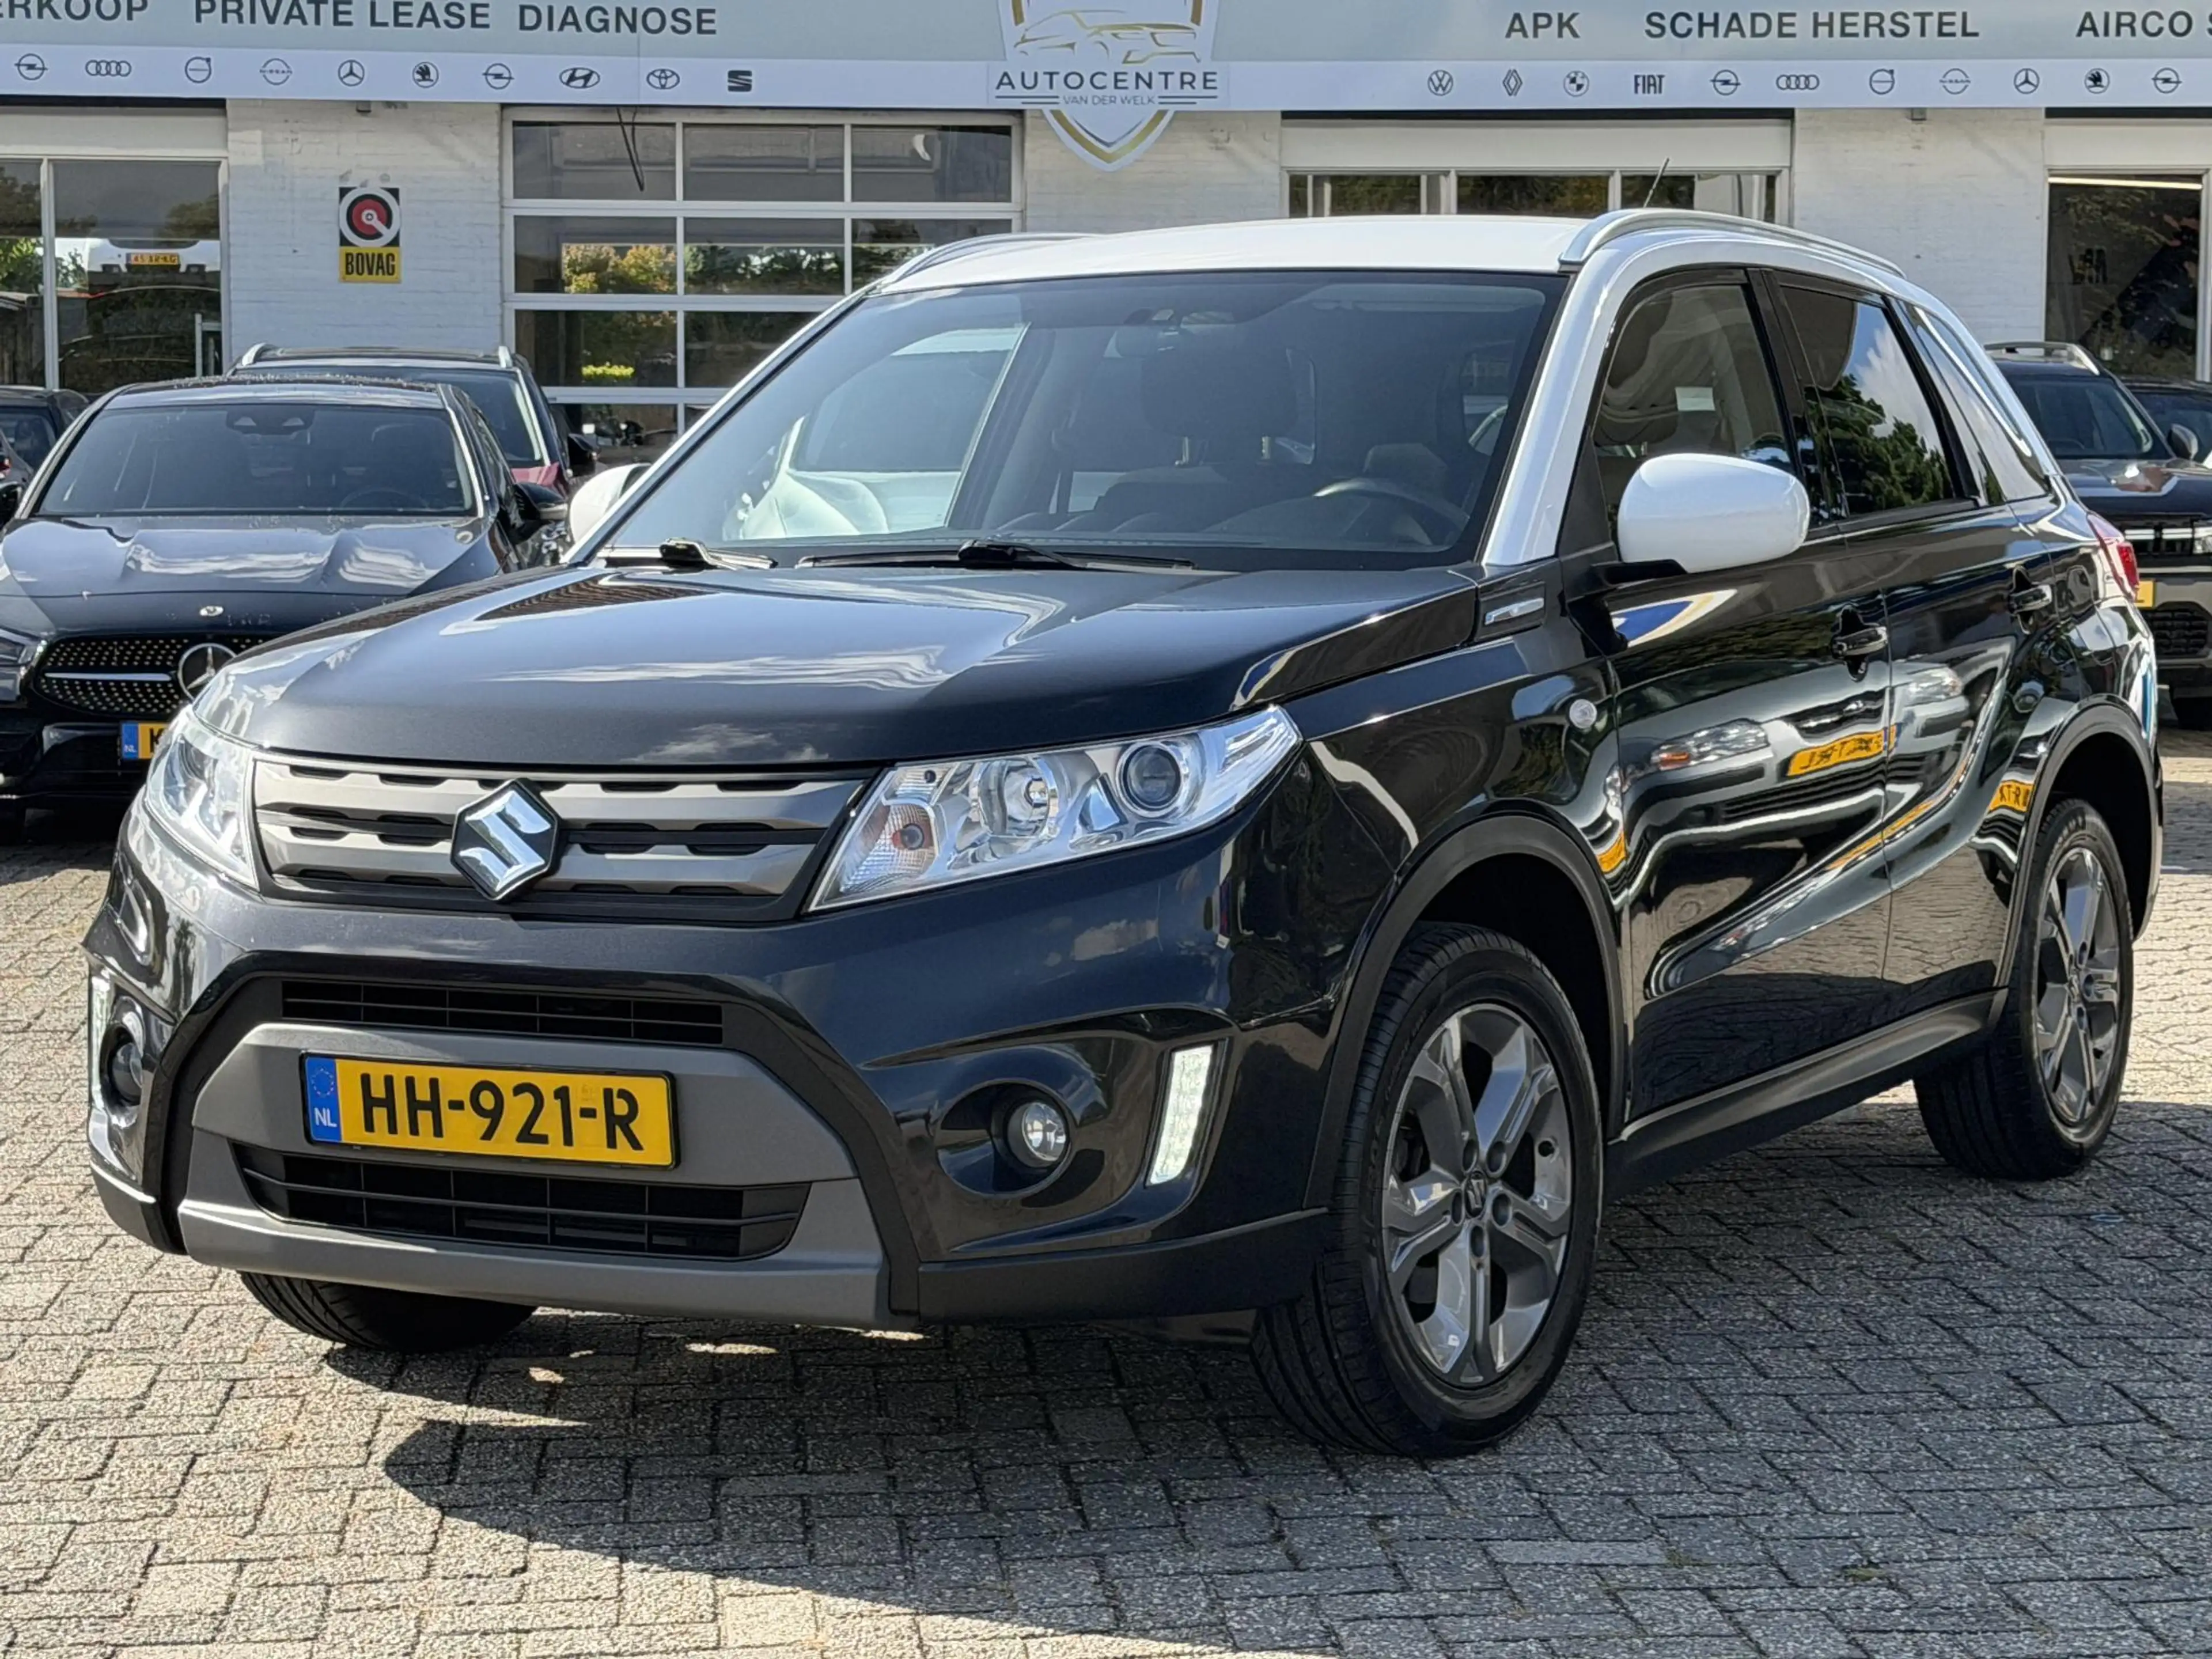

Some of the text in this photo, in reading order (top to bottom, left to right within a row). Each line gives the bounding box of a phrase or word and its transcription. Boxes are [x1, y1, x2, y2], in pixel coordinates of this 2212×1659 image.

[0, 0, 148, 21] RKOOP
[195, 0, 490, 29] PRIVATE LEASE
[518, 4, 717, 35] DIAGNOSE
[1505, 12, 1580, 39] APK
[1645, 11, 1980, 39] SCHADE HERSTEL
[2075, 10, 2193, 37] AIRCO
[995, 71, 1218, 90] AUTOCENTRE
[1634, 74, 1665, 94] FIAT
[1063, 94, 1155, 105] VAN DER WELK
[345, 252, 395, 276] BOVAG
[314, 1107, 337, 1128] NL
[360, 1072, 644, 1151] HH-921-R
